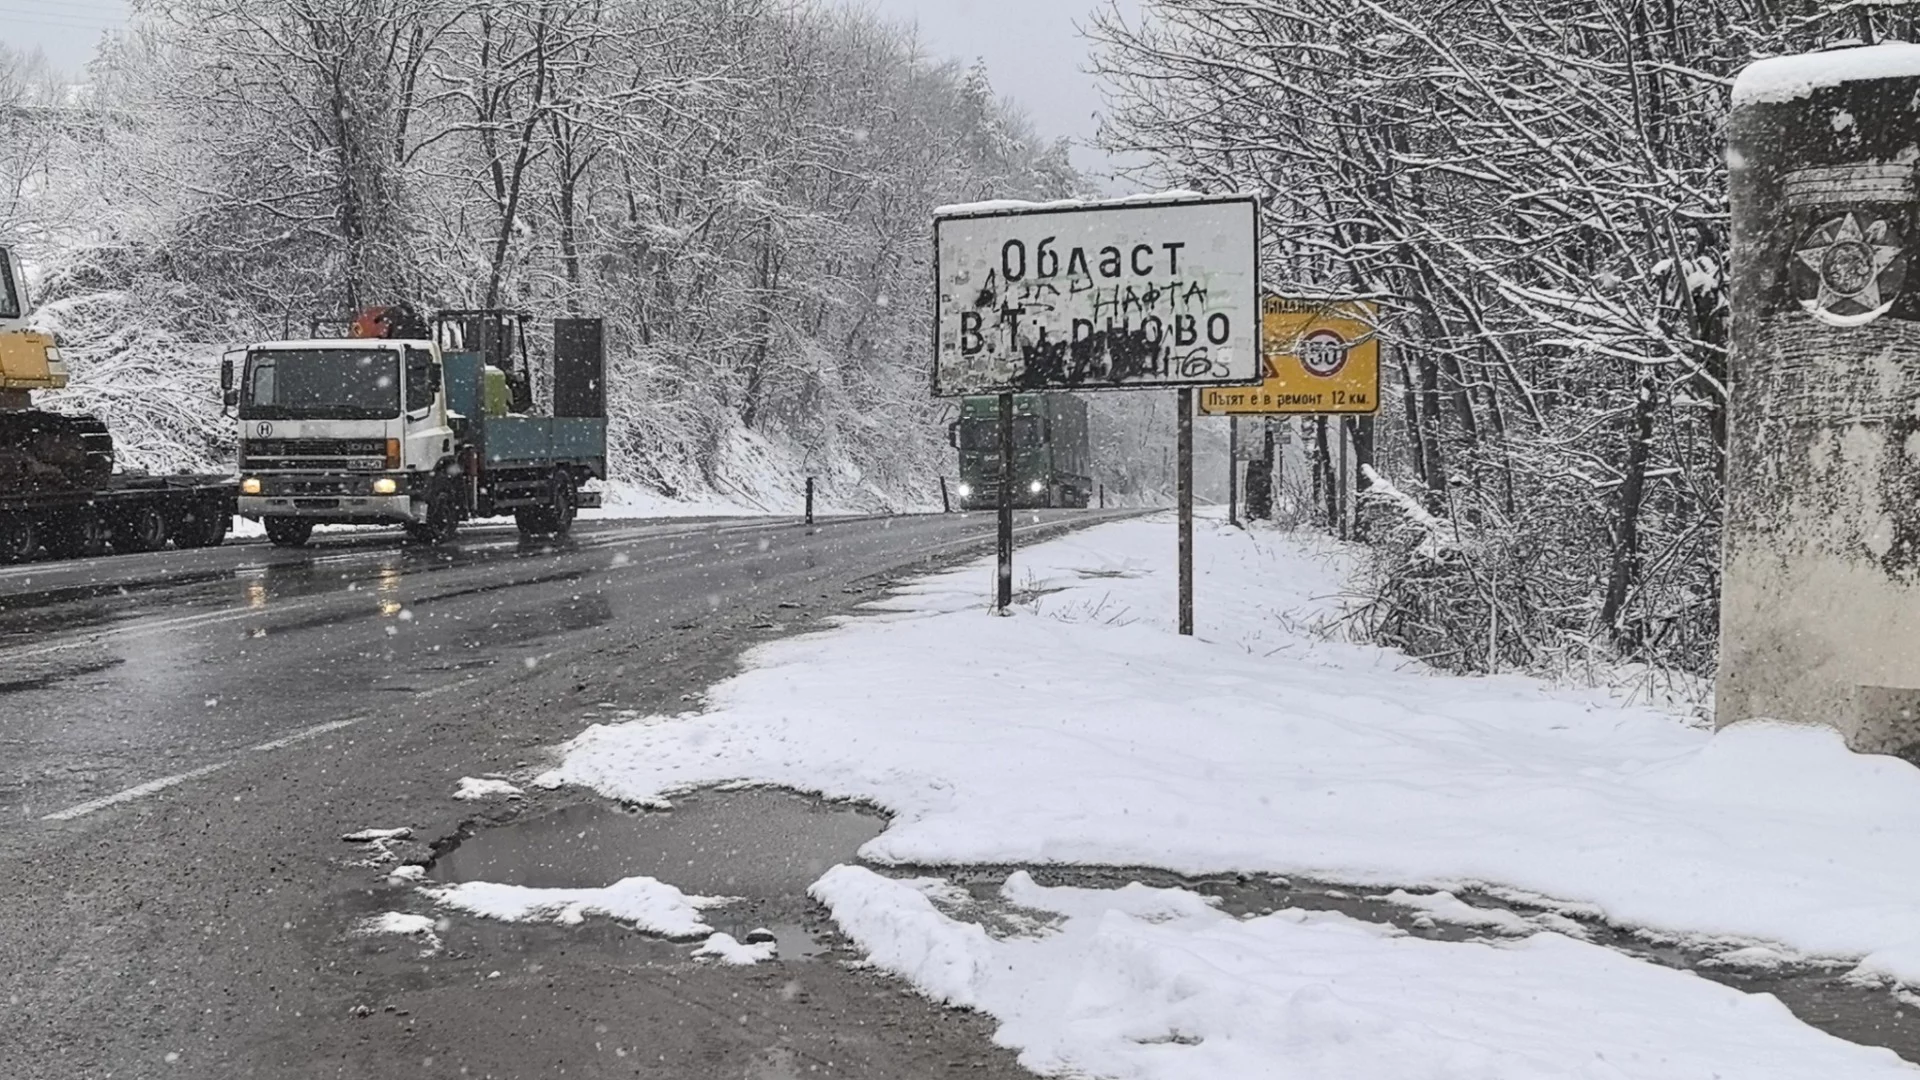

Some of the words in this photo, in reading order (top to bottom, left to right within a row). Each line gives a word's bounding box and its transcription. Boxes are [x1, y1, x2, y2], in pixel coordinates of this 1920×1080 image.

[1002, 236, 1185, 282] Област
[1093, 281, 1207, 324] НАФТА
[1208, 391, 1244, 405] Пътят
[1250, 394, 1258, 404] е
[1263, 394, 1271, 404] в
[1277, 393, 1323, 408] ремонт
[1332, 391, 1345, 405] 12
[351, 443, 385, 451] DAF
